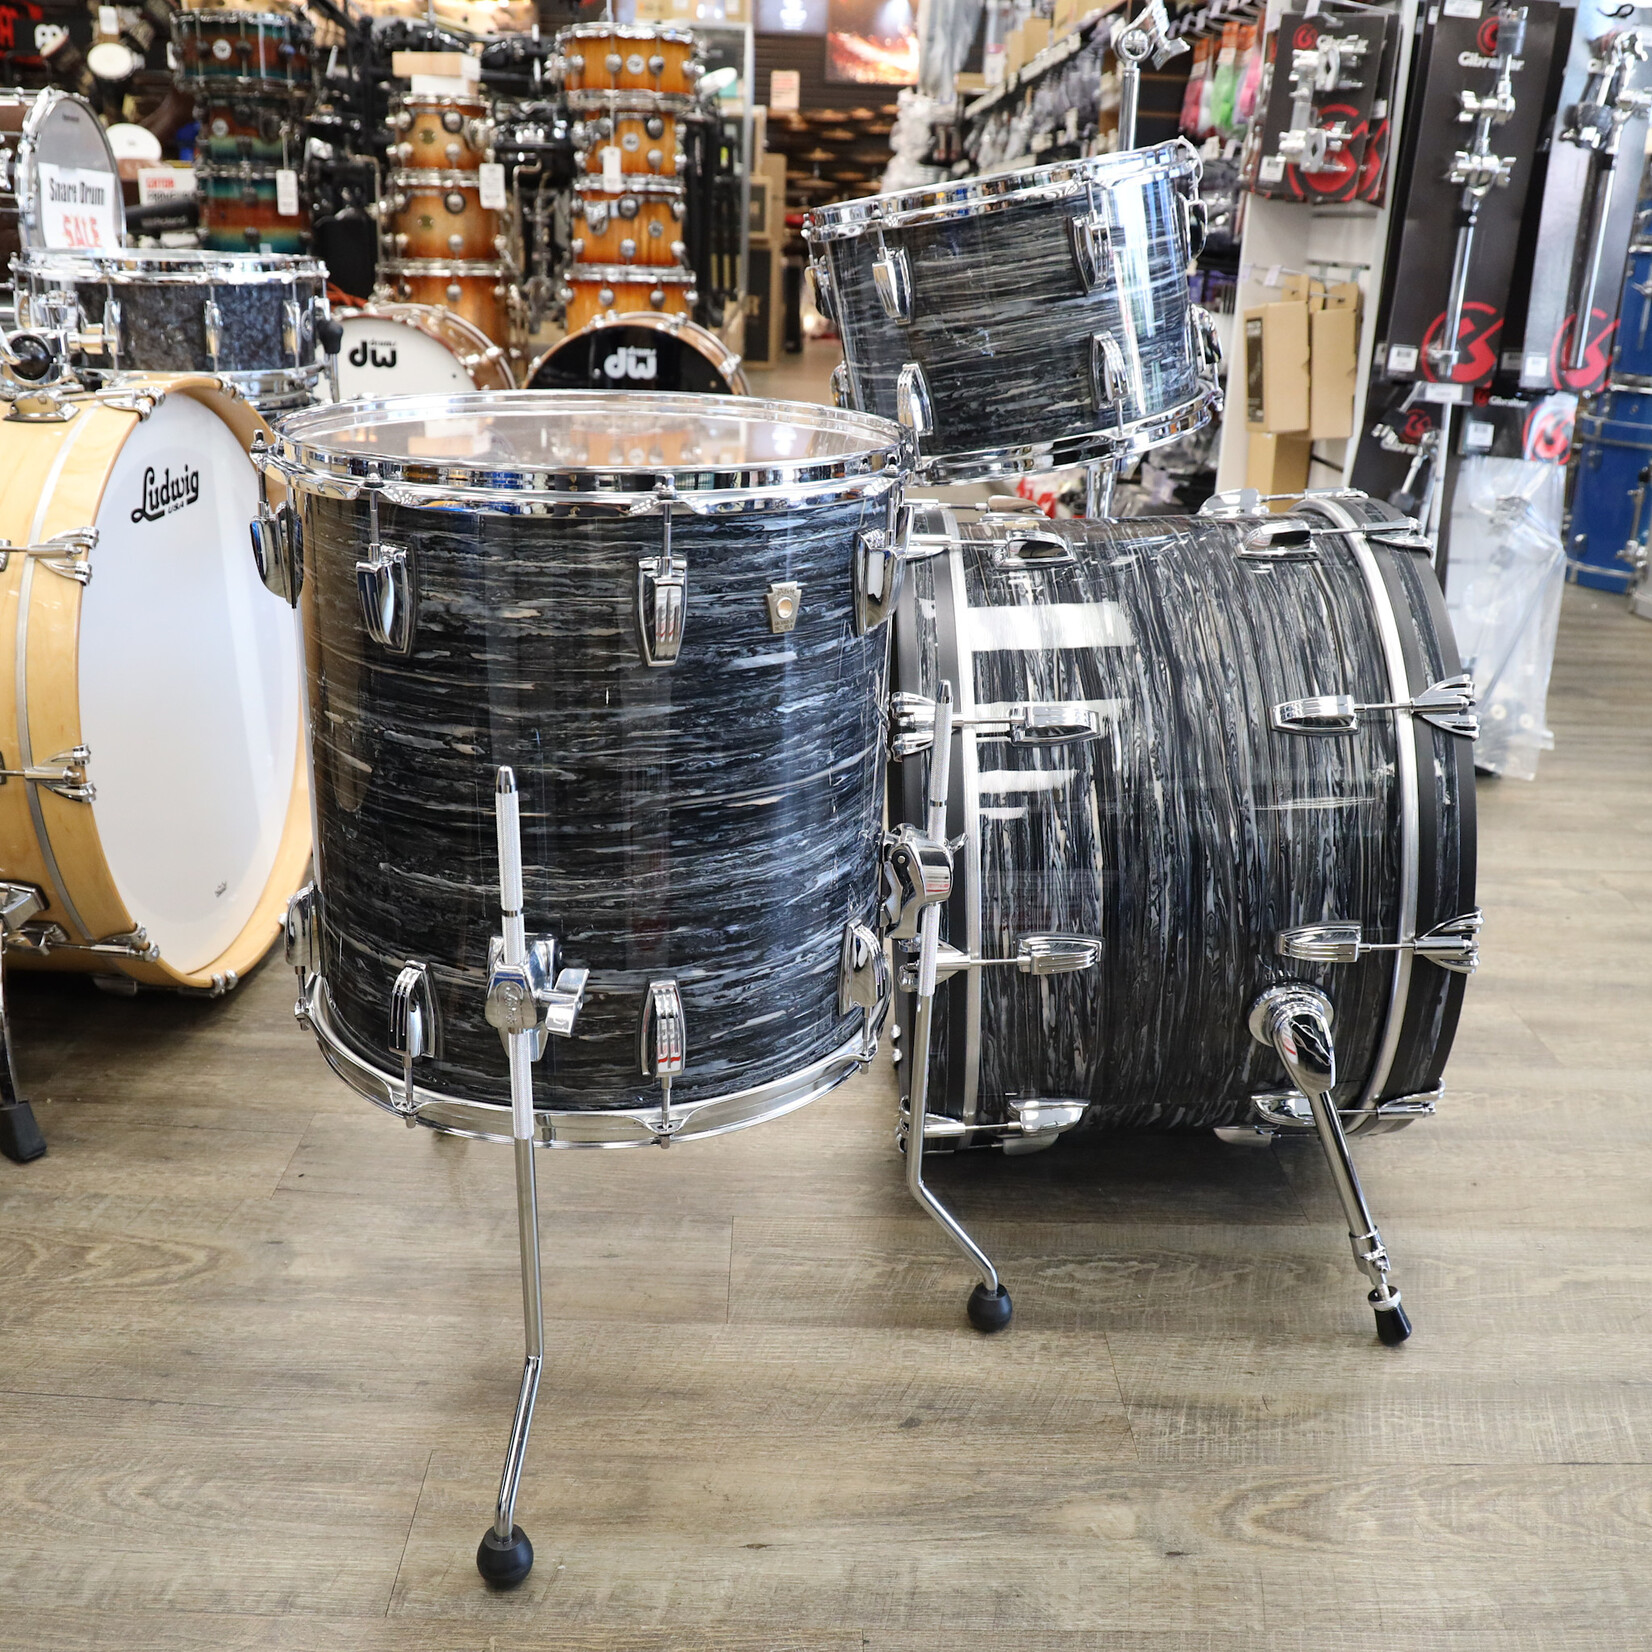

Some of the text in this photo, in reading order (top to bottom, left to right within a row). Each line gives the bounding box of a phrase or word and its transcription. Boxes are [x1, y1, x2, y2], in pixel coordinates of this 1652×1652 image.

[49, 177, 105, 206] Snare Drum
[63, 214, 103, 248] SALE
[349, 340, 397, 368] dw
[604, 346, 657, 380] dw
[131, 463, 199, 523] Ludwig
